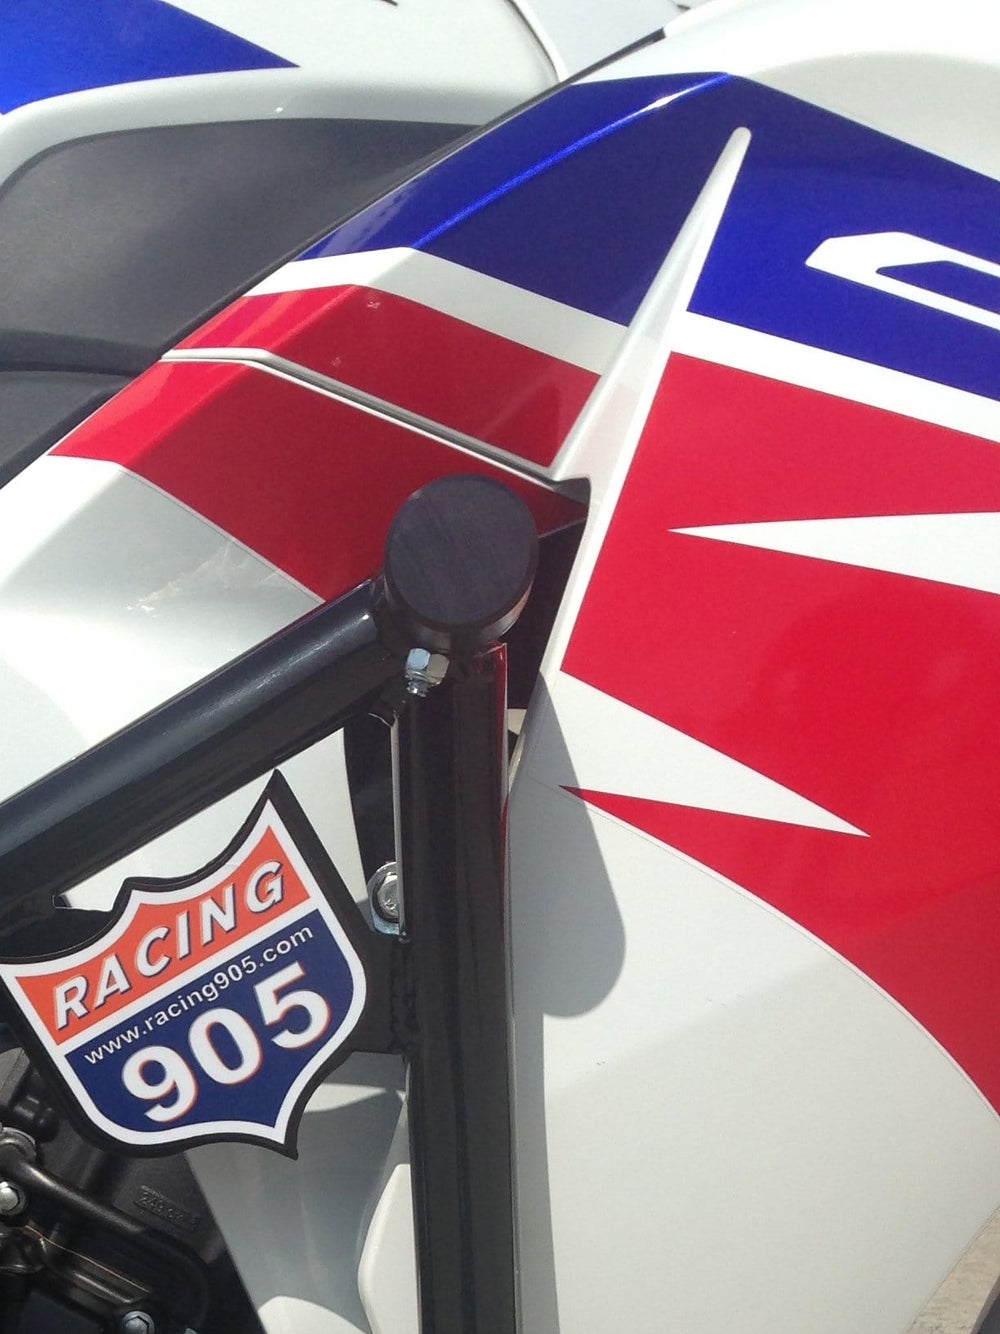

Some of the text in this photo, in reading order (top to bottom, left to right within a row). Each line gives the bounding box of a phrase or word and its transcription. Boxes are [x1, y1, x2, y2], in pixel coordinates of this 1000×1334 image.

[53, 861, 283, 1031] RACING
[84, 926, 313, 1065] www.racing905.com
[121, 962, 331, 1122] 905
